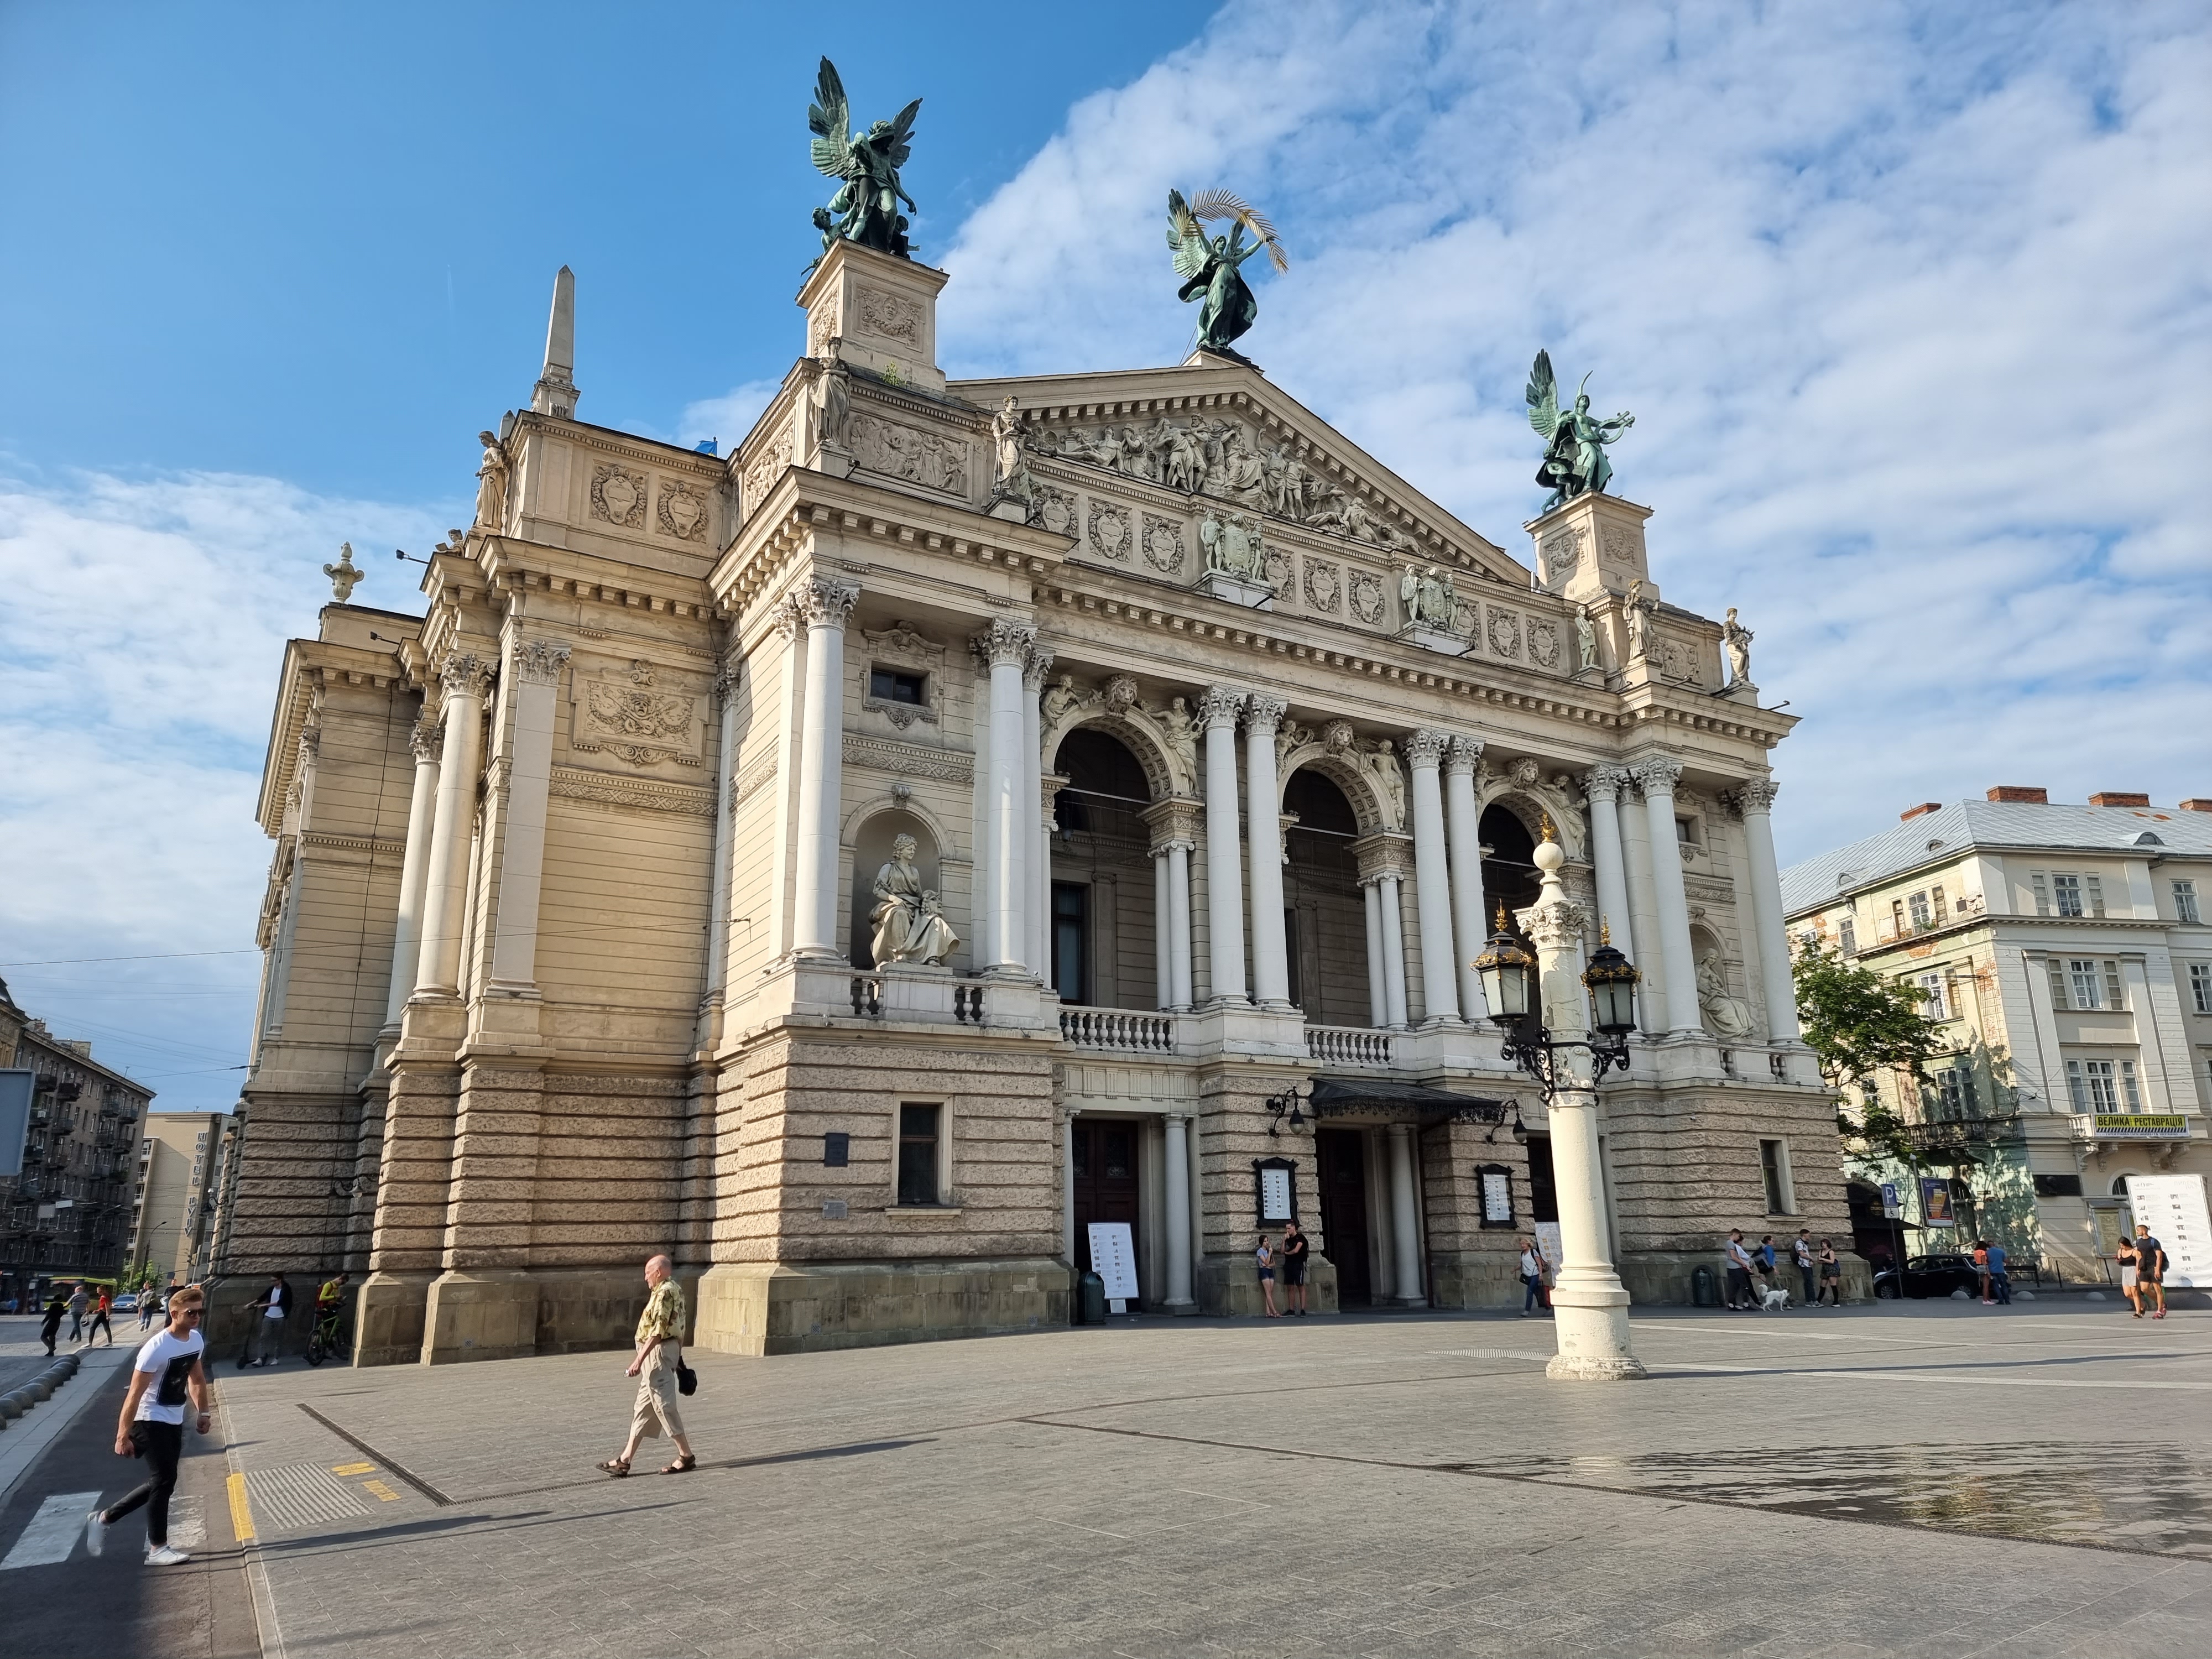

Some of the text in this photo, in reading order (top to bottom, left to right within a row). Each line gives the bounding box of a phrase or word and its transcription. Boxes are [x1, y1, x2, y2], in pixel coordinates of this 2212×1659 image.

[2098, 1117, 2183, 1128] ВЕЛИКА РЕСТАВРАЦІЯ
[184, 1132, 207, 1237] HOTEL LVIV
[1885, 1186, 1893, 1204] P
